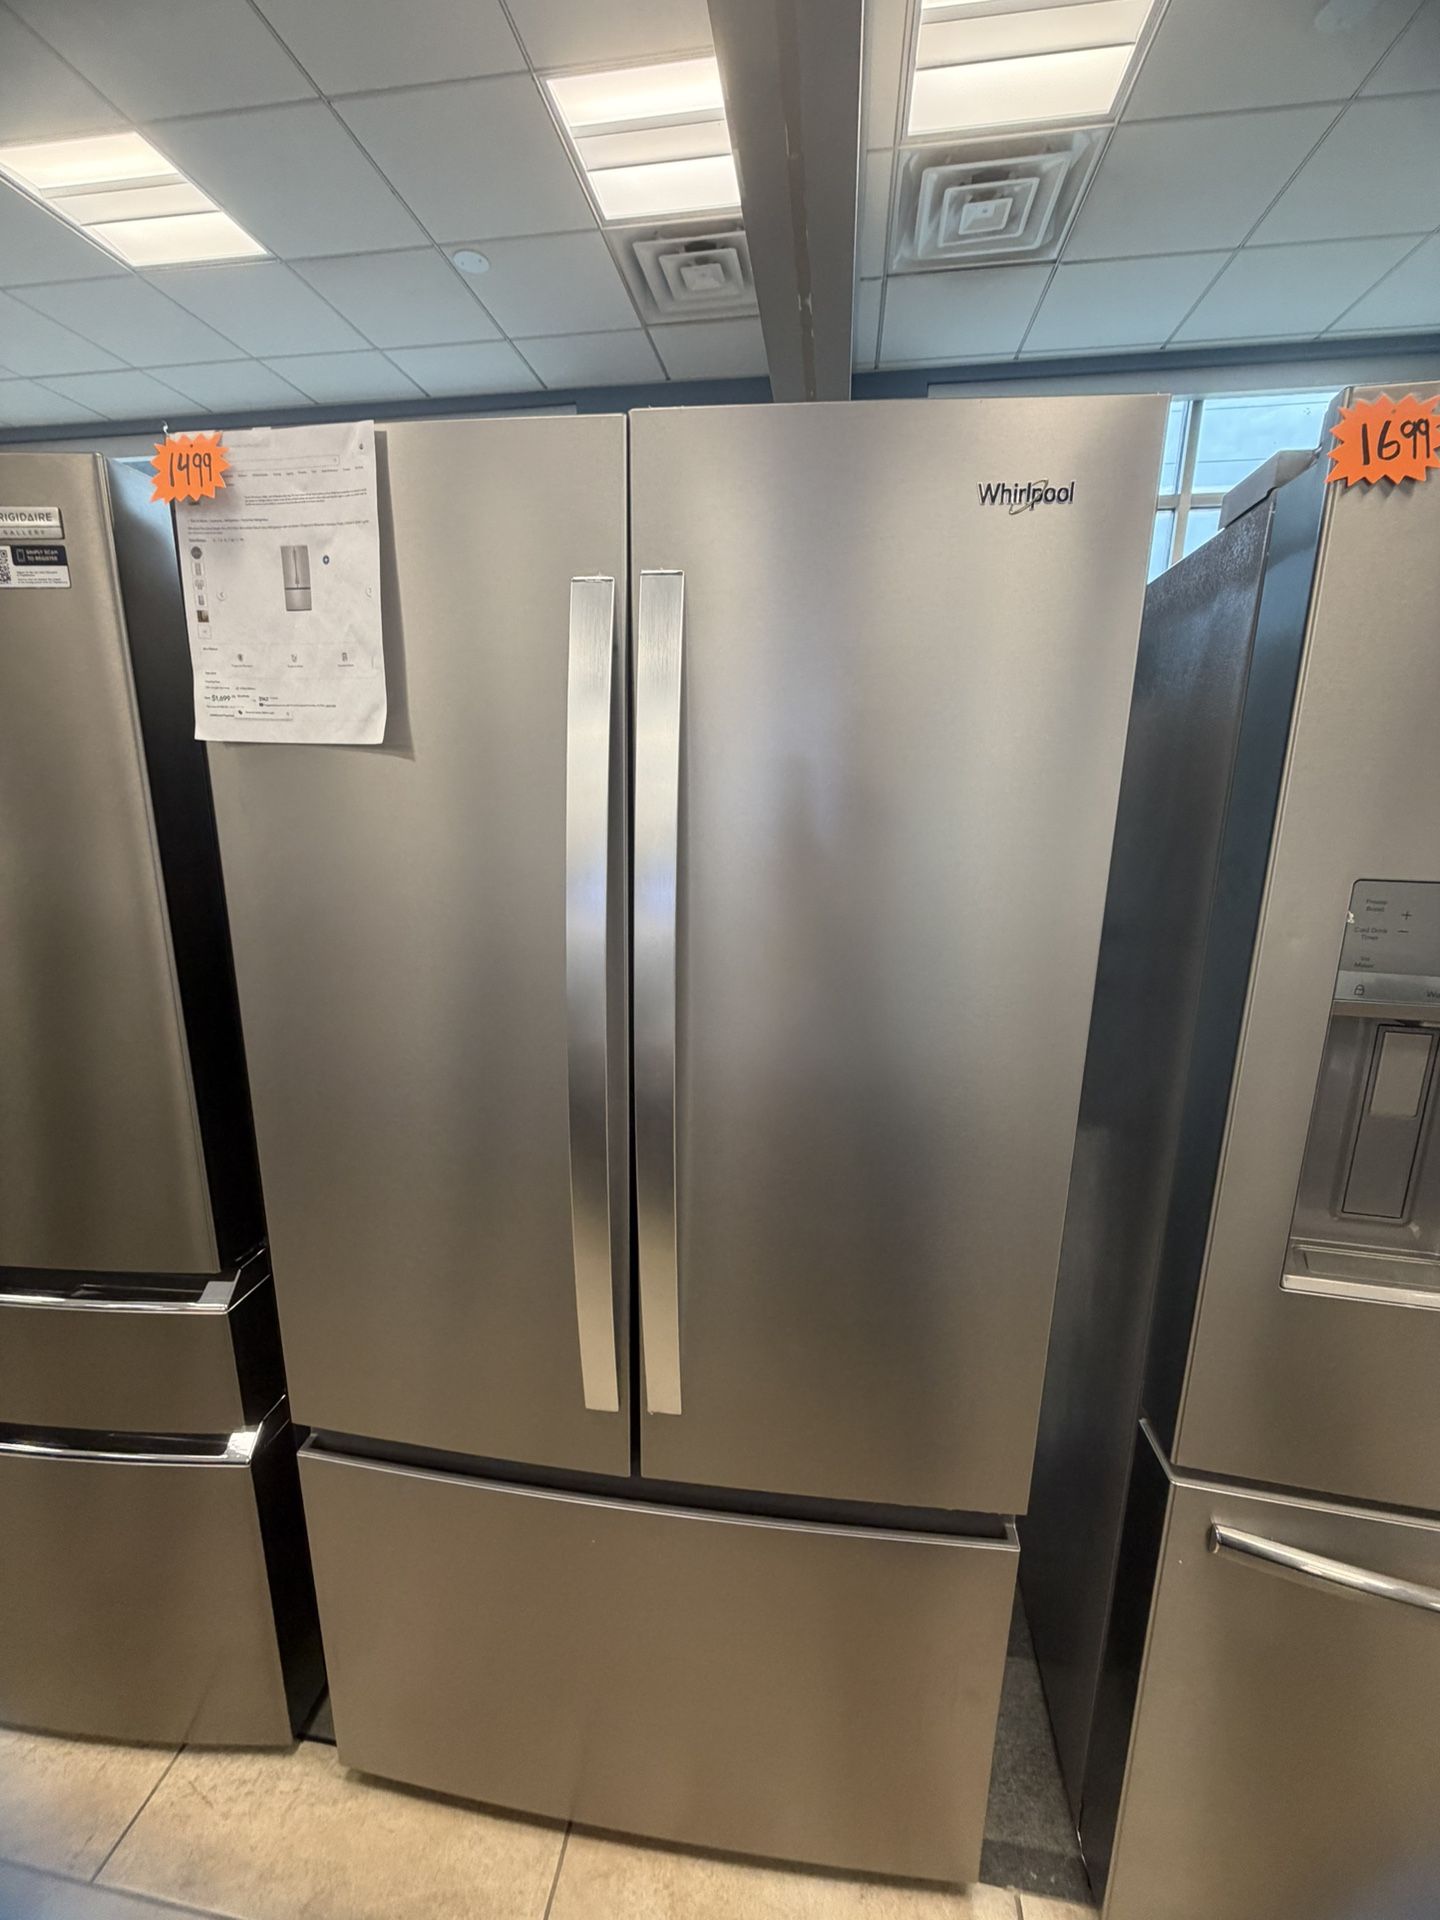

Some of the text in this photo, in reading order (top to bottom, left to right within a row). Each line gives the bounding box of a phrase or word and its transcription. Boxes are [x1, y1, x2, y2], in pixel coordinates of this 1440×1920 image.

[1361, 418, 1430, 467] 1699
[169, 451, 213, 488] 1499
[978, 481, 1075, 511] Whirlpool
[0, 511, 53, 522] RIGIDAIRE
